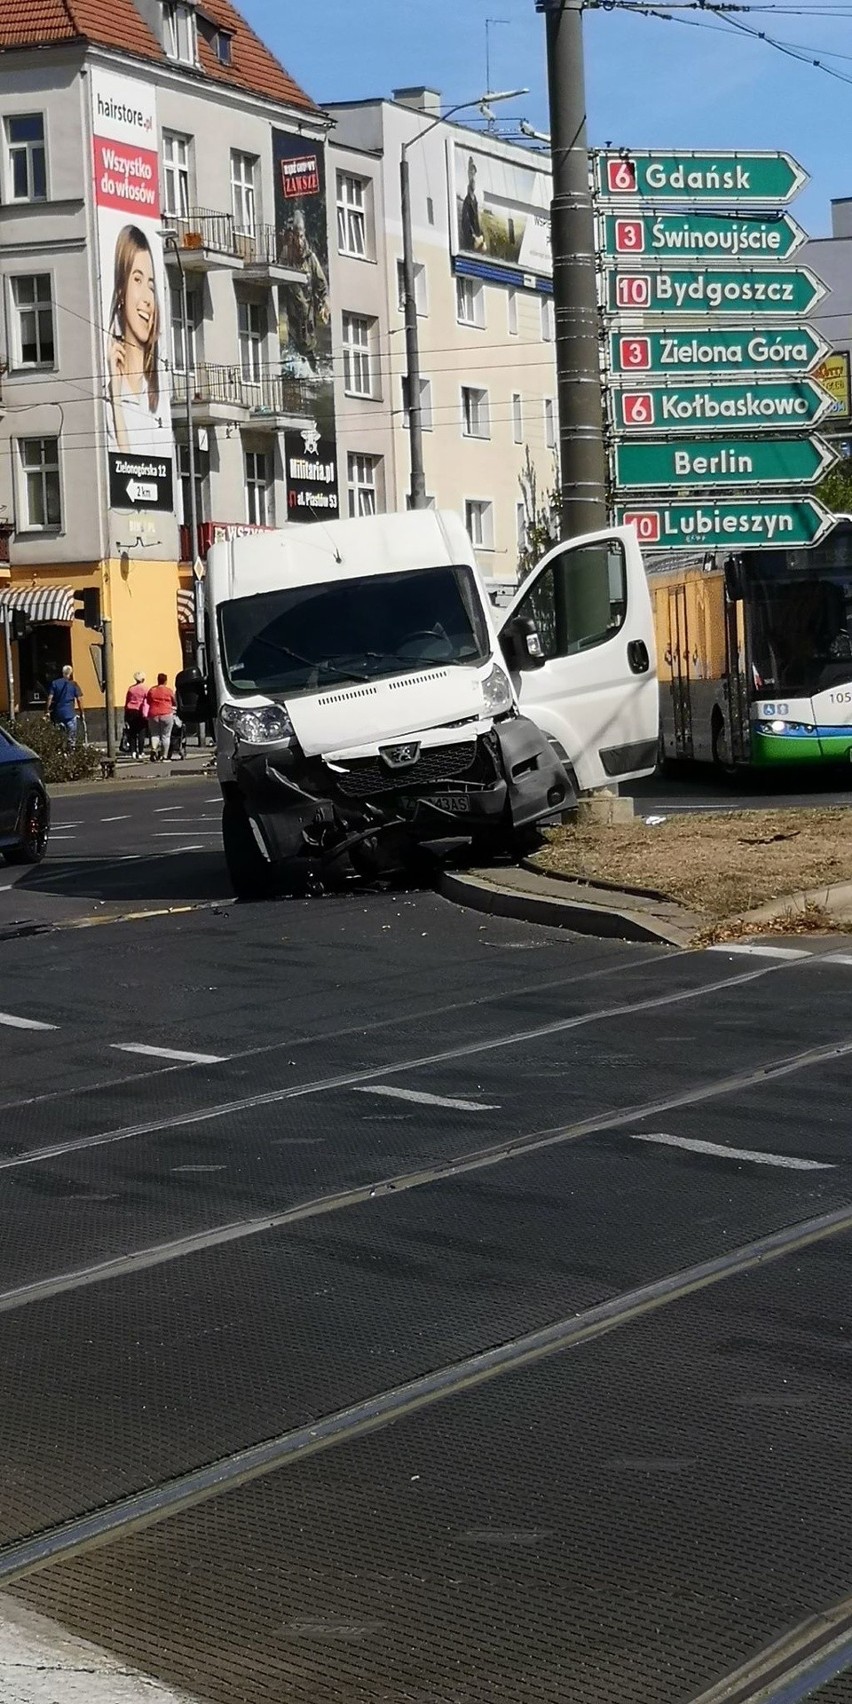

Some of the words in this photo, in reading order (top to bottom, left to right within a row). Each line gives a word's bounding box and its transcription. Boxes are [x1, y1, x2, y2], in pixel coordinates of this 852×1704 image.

[97, 92, 152, 132] hairstore.pl
[102, 147, 152, 180] Wszystko
[614, 163, 632, 188] 6
[645, 163, 751, 189] Gdańsk
[101, 174, 115, 195] do
[115, 177, 156, 205] włosów
[285, 173, 318, 193] ZAWSZE
[623, 226, 637, 247] 3
[651, 218, 781, 254] Świnoujście
[619, 279, 648, 303] 10
[656, 275, 794, 306] Bydgoszcz
[628, 343, 643, 364] 3
[659, 339, 742, 364] Zielona
[747, 336, 808, 362] Góra
[630, 396, 647, 421] 6
[662, 393, 809, 419] Kołbaskowo
[157, 464, 167, 478] 12
[289, 458, 334, 484] Militaria.pl
[674, 449, 753, 475] Berlin
[141, 486, 151, 498] km
[664, 510, 793, 538] Lubieszyn
[829, 692, 852, 704] 105
